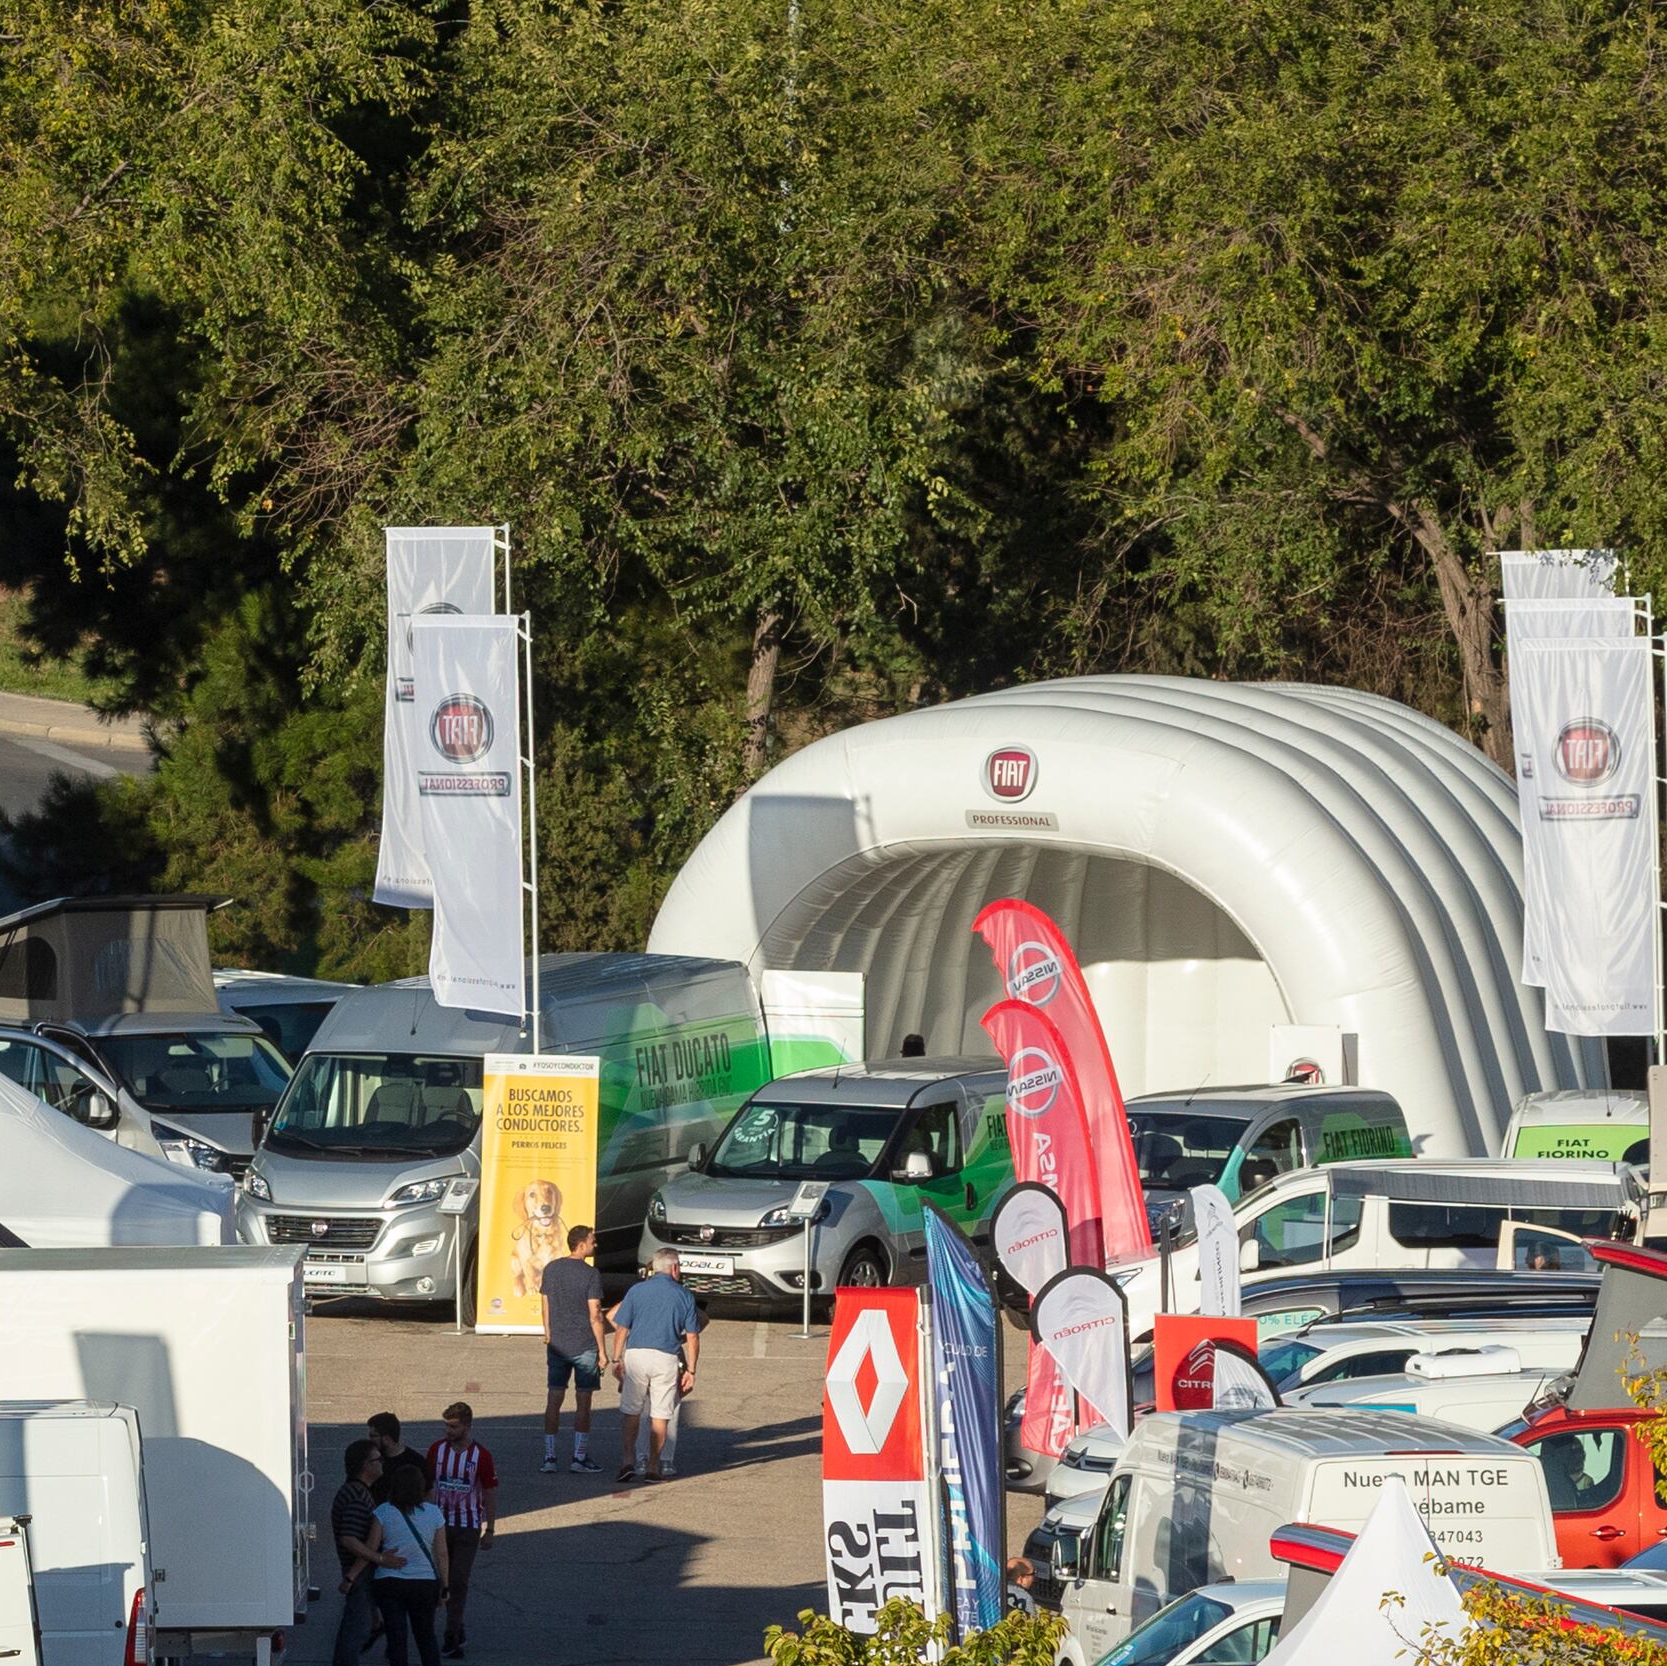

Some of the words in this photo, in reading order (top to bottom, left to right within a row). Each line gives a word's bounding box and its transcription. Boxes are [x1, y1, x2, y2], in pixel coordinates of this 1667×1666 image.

[993, 759, 1028, 787] FIAT
[972, 814, 1053, 827] PROFESSIONAL
[635, 1043, 668, 1089] FIAT
[672, 1032, 732, 1082] DUCATO
[508, 1088, 573, 1104] BUSCAMOS
[496, 1103, 505, 1117] A
[507, 1103, 530, 1117] LOS
[533, 1104, 586, 1119] MEJORES
[753, 1109, 776, 1126] 5
[496, 1117, 585, 1134] CONDUCTORES.
[511, 1140, 540, 1150] PERROS
[541, 1142, 568, 1151] FELICES
[1323, 1130, 1350, 1159] FIAT
[1350, 1125, 1396, 1156] FIORINO
[1557, 1139, 1591, 1147] FIAT
[1538, 1150, 1609, 1159] FIORINO
[1178, 1378, 1213, 1390] CITR
[1344, 1471, 1406, 1489] Nuea
[1413, 1470, 1461, 1488] MAN
[1467, 1469, 1509, 1487] TGE
